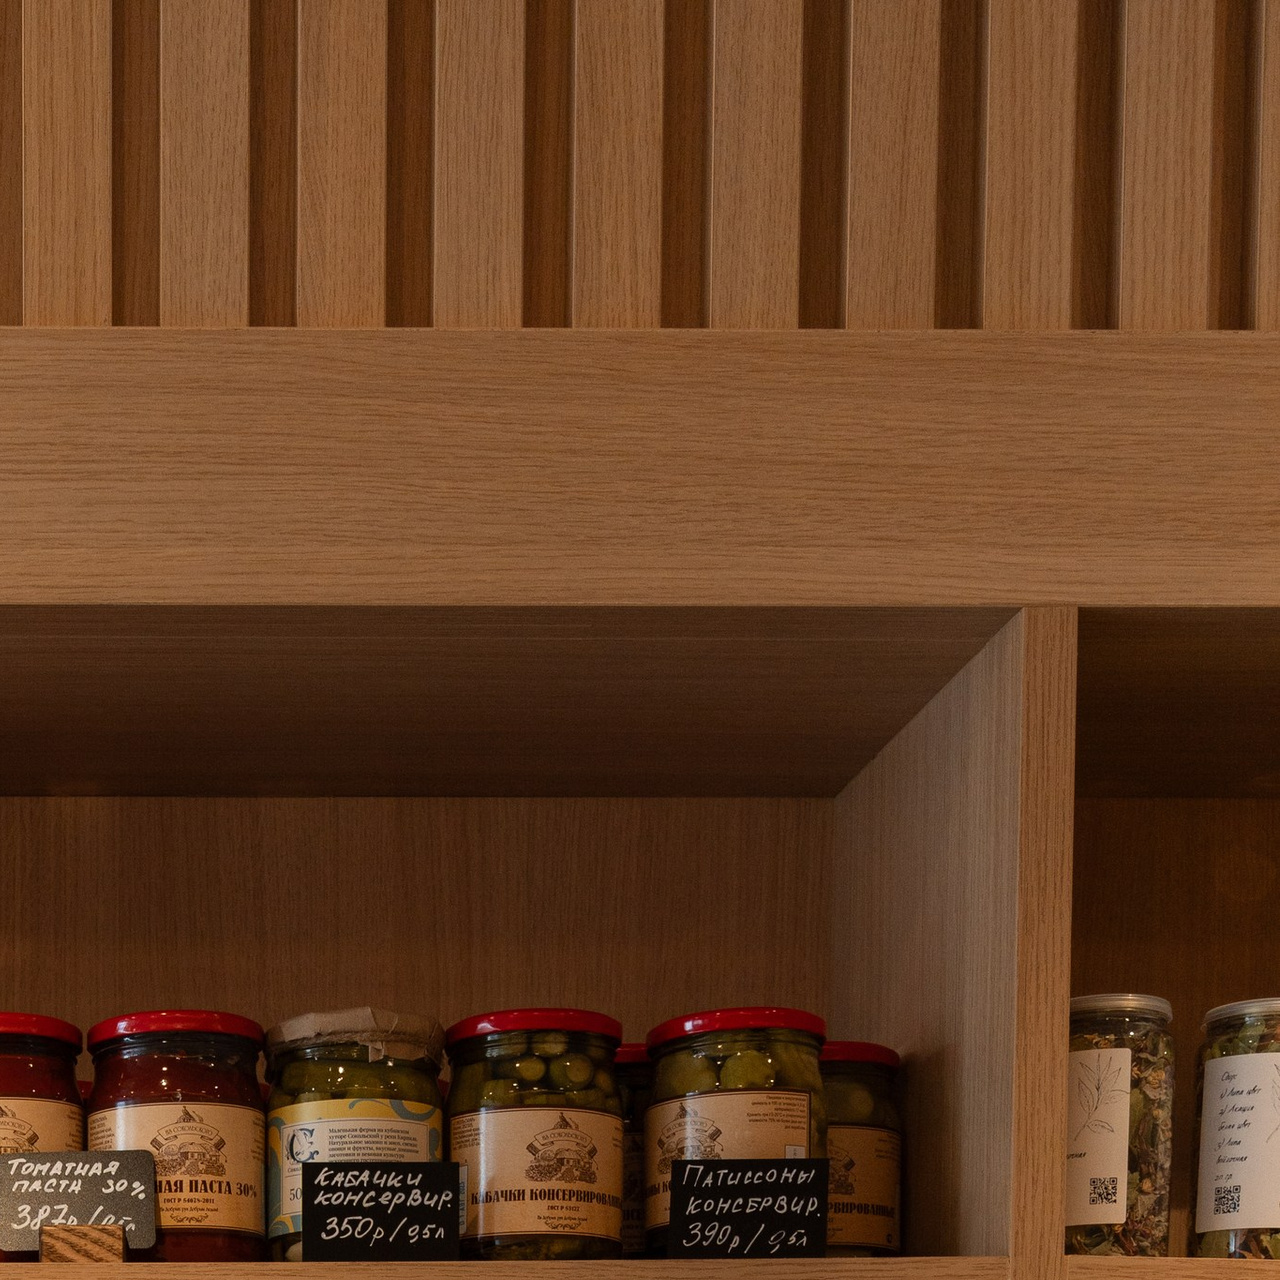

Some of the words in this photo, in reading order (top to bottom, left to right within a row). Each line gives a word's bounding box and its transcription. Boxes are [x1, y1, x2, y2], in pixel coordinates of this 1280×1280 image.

[8, 1158, 120, 1177] ТОМАТНАЯ
[683, 1164, 815, 1188] ПАТИССОНЫ
[314, 1167, 422, 1188] КАБАЧКИ
[189, 1180, 232, 1194] ПАСТА
[236, 1183, 257, 1198] 30%
[471, 1188, 525, 1205] КАБАЧКИ
